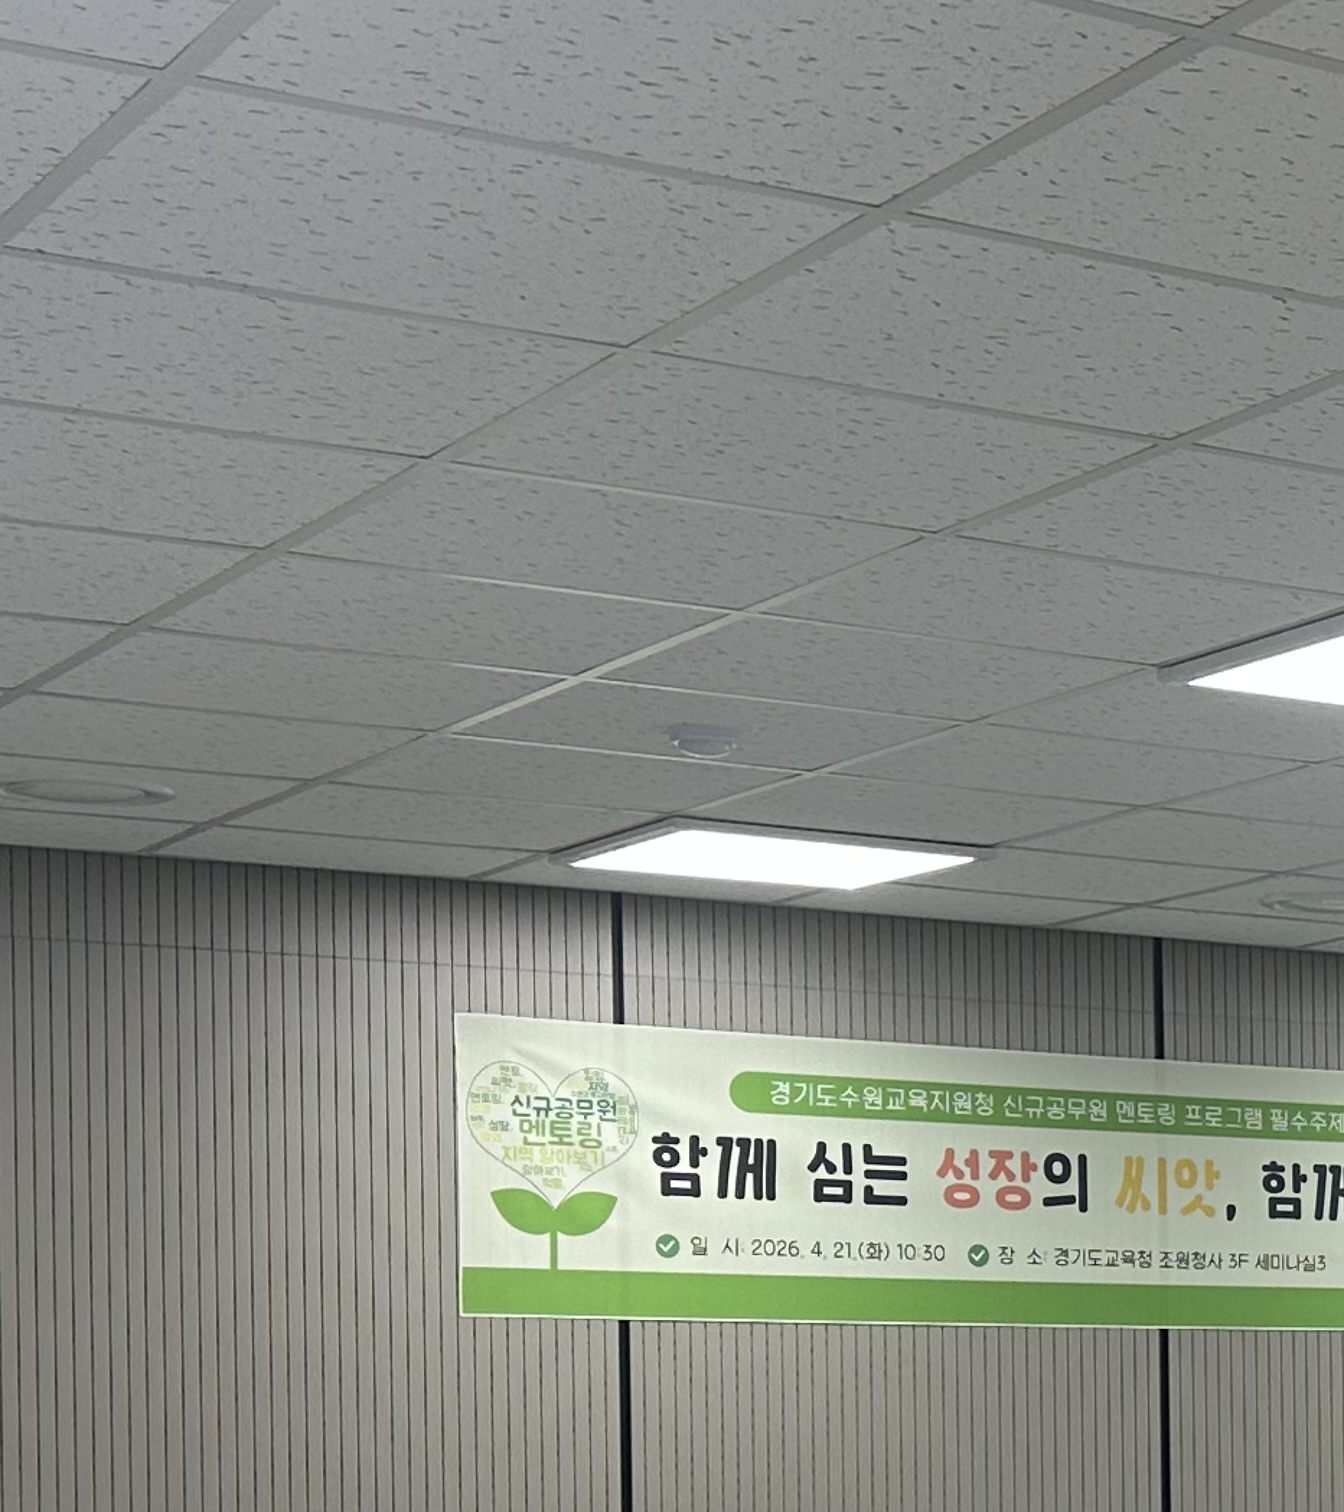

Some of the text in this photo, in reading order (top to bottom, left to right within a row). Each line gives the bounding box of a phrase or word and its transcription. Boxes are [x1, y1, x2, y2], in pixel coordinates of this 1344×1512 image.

[510, 1095, 618, 1123] 신규공무원
[769, 1080, 994, 1116] 경기도수원교육지원청
[1002, 1095, 1107, 1122] 신규공무원
[1115, 1100, 1176, 1126] 멘토링
[1184, 1104, 1263, 1131] 프로그램
[519, 1119, 602, 1149] 멘토링
[651, 1131, 777, 1201] 함께
[807, 1140, 908, 1206] 심는
[935, 1147, 1088, 1213] 성장의
[1115, 1155, 1237, 1222] 씨앗,
[751, 1239, 805, 1259] 2026.
[897, 1243, 946, 1262] 10:30
[1053, 1248, 1153, 1269] 경기도교육청
[1159, 1250, 1224, 1270] 조원청사
[1228, 1252, 1249, 1270] 3F
[1254, 1252, 1327, 1272] 세미나실3
